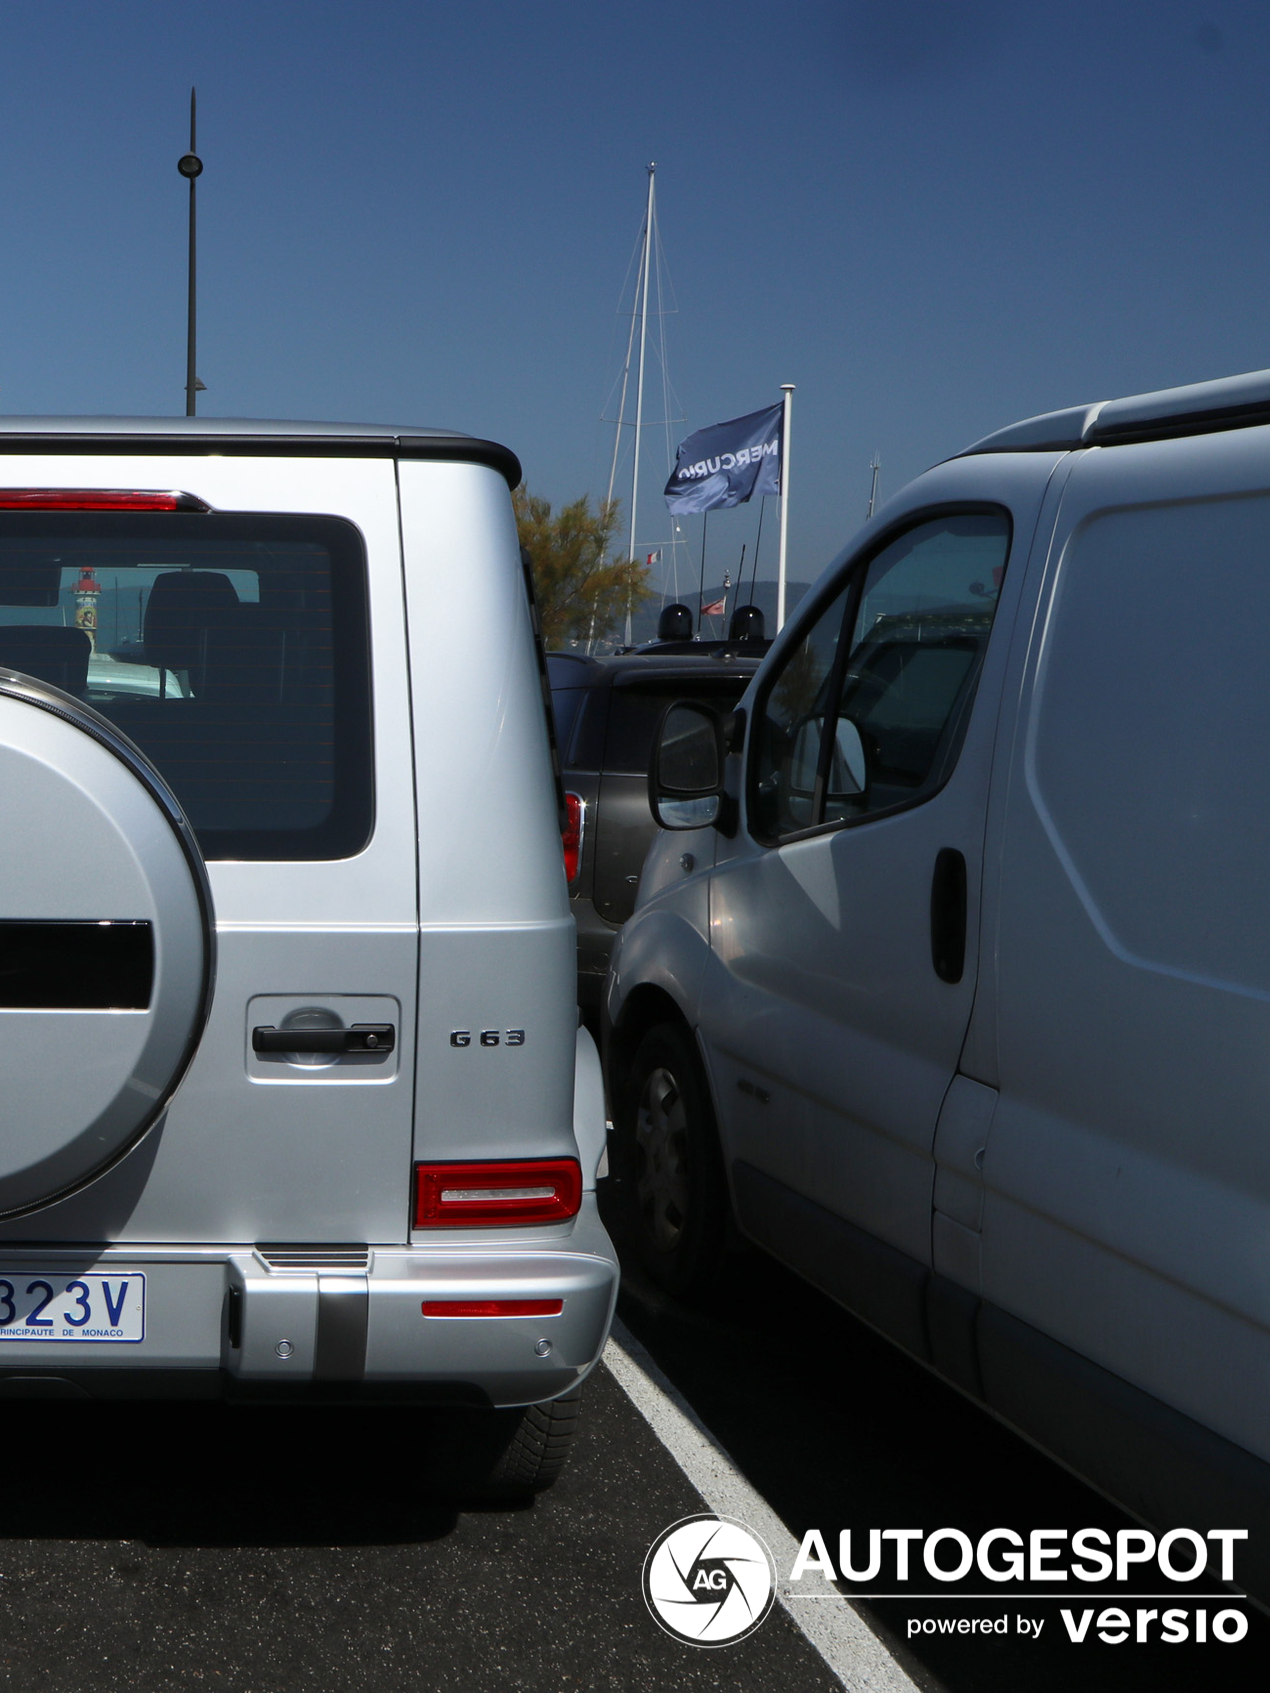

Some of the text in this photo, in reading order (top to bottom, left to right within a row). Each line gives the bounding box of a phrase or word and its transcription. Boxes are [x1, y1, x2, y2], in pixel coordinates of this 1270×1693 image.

[450, 1029, 525, 1047] G 63
[62, 1329, 74, 1337] DE
[82, 1329, 124, 1337] MONACO
